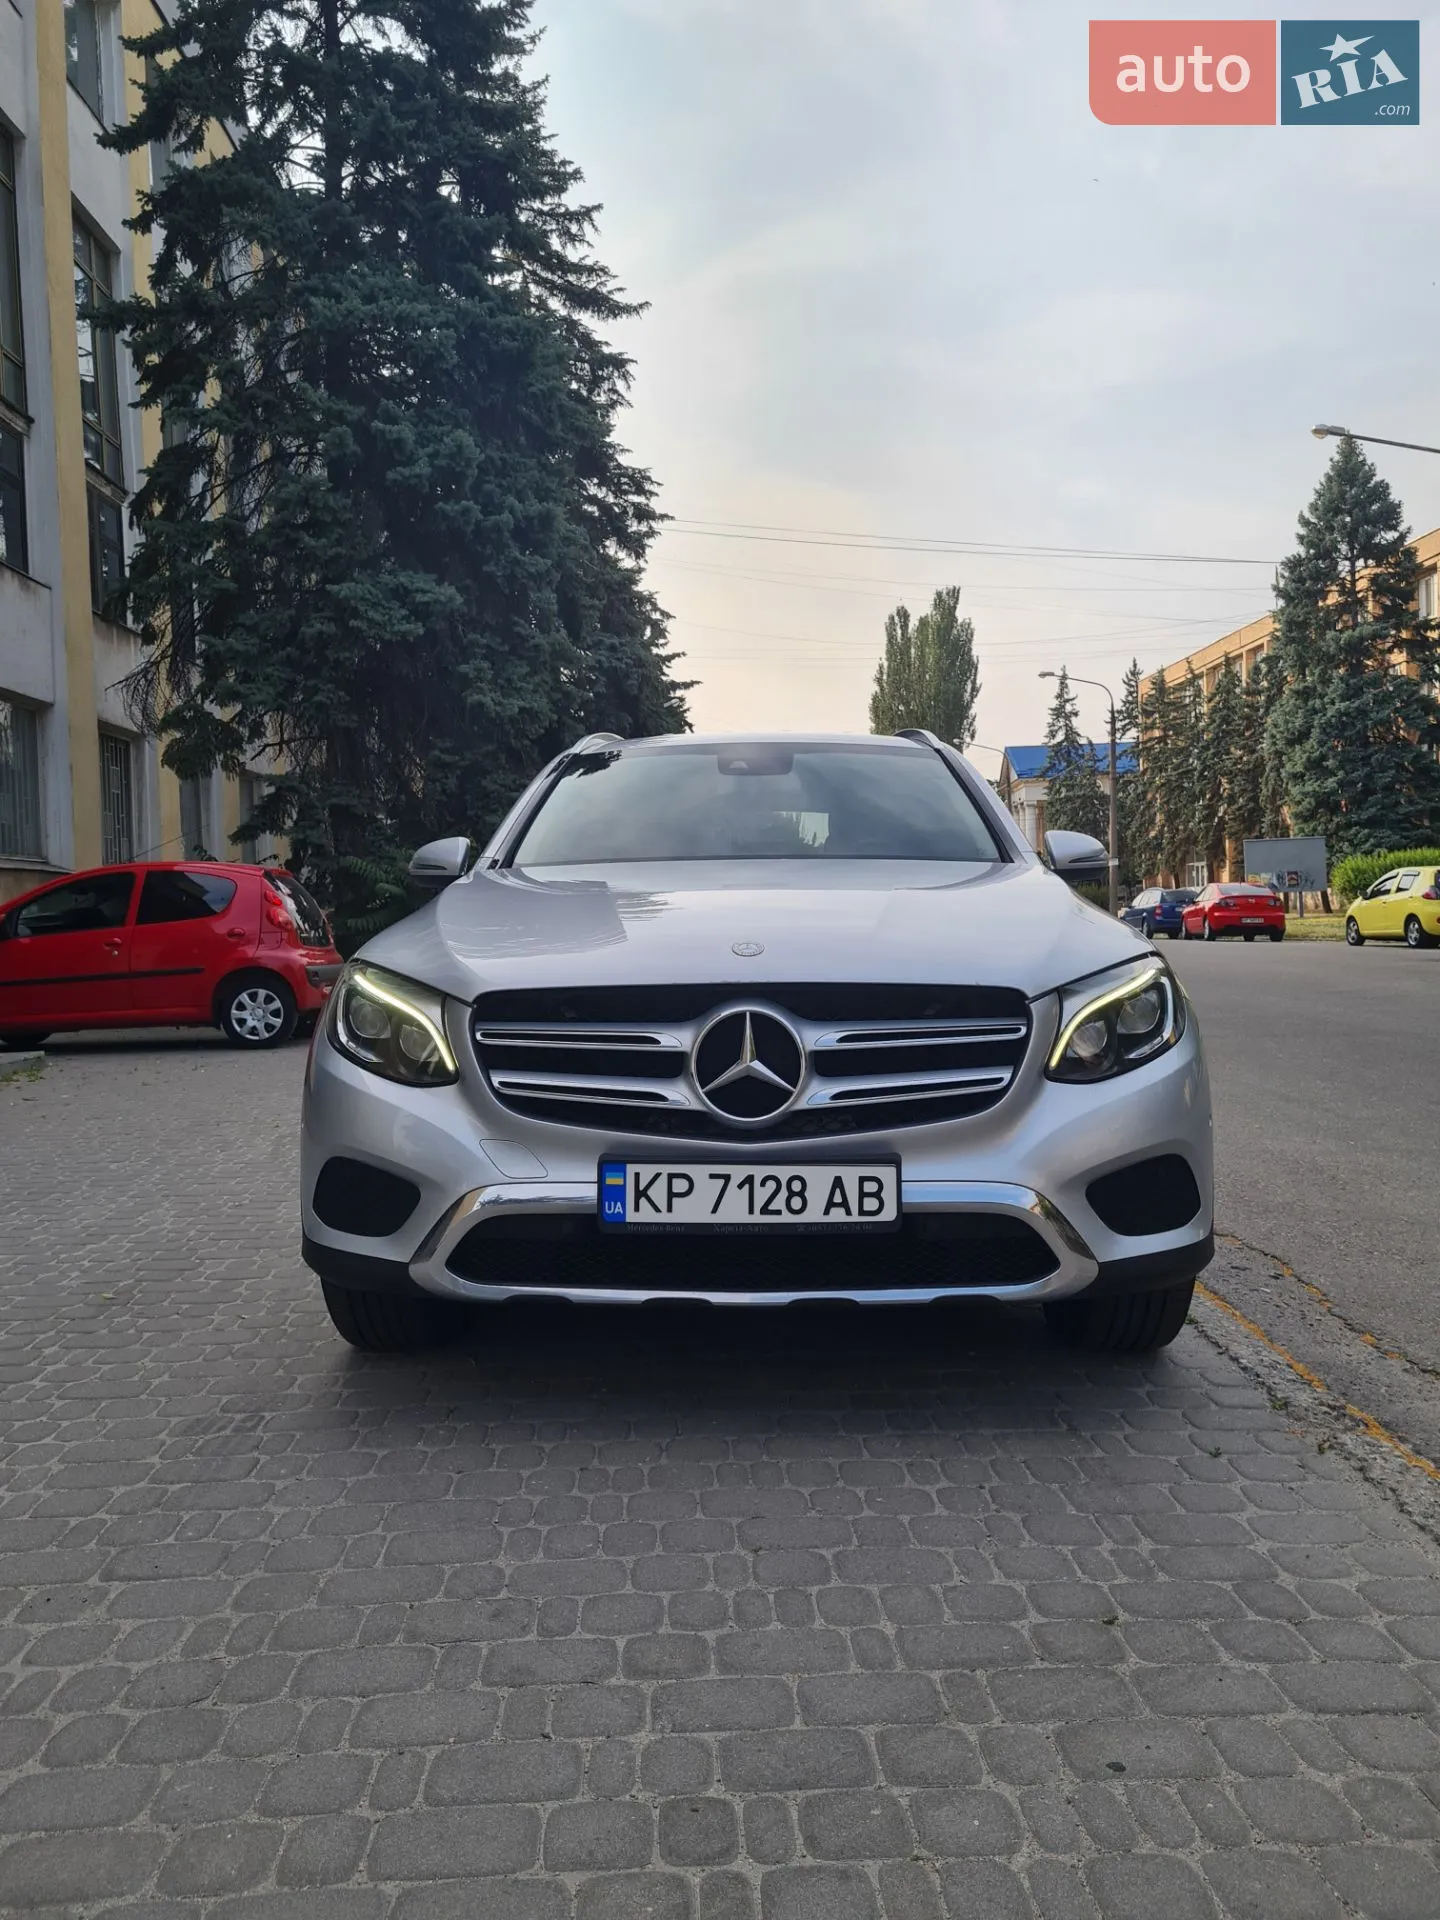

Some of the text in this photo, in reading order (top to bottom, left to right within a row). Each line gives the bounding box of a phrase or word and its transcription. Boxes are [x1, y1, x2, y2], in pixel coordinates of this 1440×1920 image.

[605, 1201, 624, 1215] UA
[633, 1171, 885, 1217] KP 7128 AB
